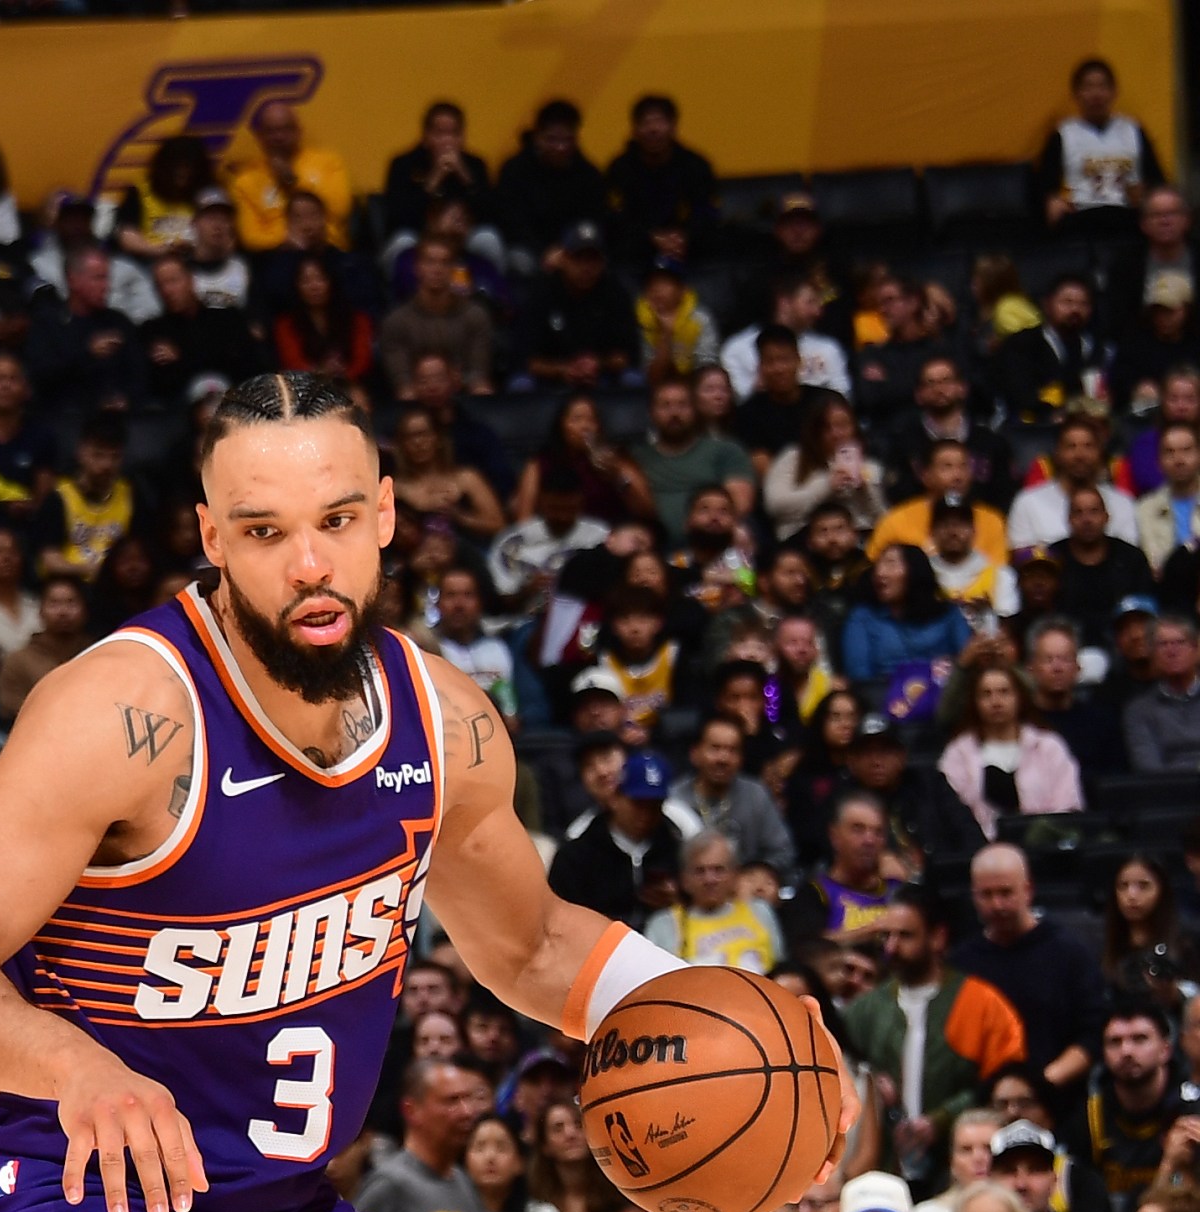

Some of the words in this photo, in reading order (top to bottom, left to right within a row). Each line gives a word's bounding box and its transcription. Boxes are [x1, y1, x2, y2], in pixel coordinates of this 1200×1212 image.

[116, 703, 184, 765] W
[462, 711, 495, 769] P
[375, 761, 432, 793] PayPal
[133, 874, 402, 1020] SUNS
[580, 1028, 688, 1086] ilson
[247, 1026, 336, 1163] 3
